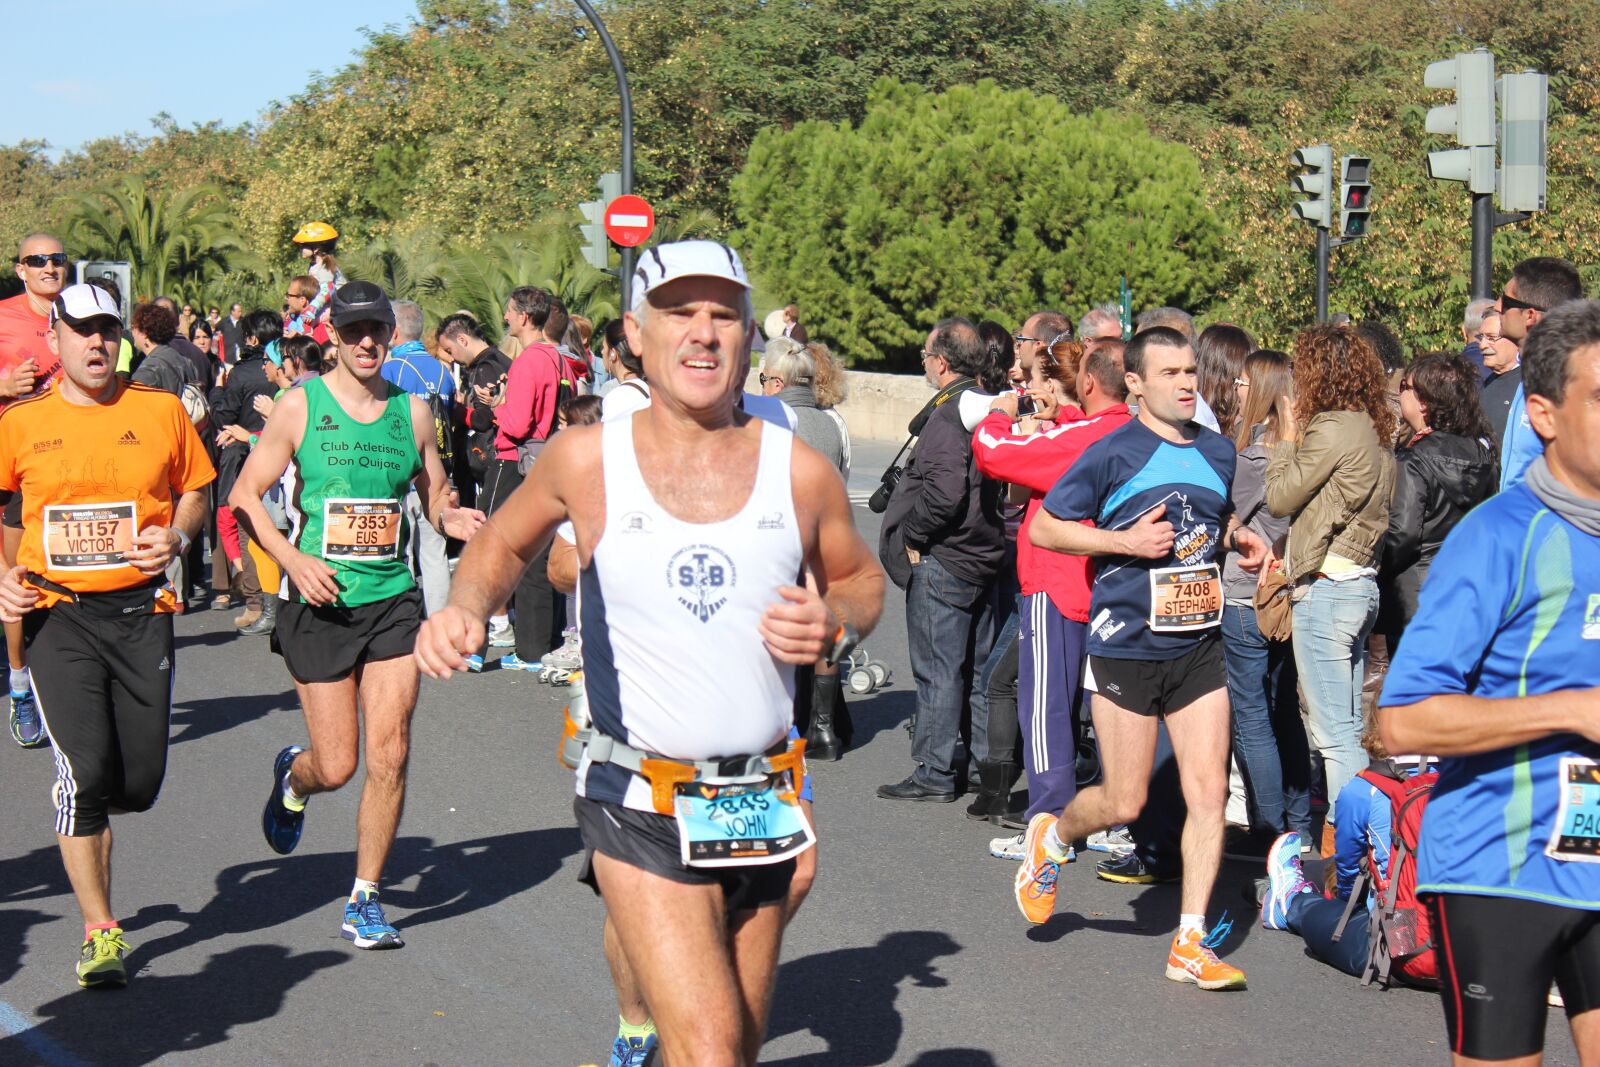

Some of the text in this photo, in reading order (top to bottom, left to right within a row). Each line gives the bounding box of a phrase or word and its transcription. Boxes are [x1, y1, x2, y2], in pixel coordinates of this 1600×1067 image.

[52, 438, 63, 446] 49
[320, 442, 406, 457] Club Atletismo
[327, 456, 401, 471] Don Quijote
[61, 520, 119, 538] 11157
[347, 515, 387, 529] 7353
[68, 537, 115, 553] VICTOR
[356, 531, 378, 545] EUS
[1175, 532, 1209, 561] VALENCIA
[1173, 581, 1210, 599] 7408
[1164, 596, 1216, 615] STEPHANE
[724, 815, 768, 838] JOHN
